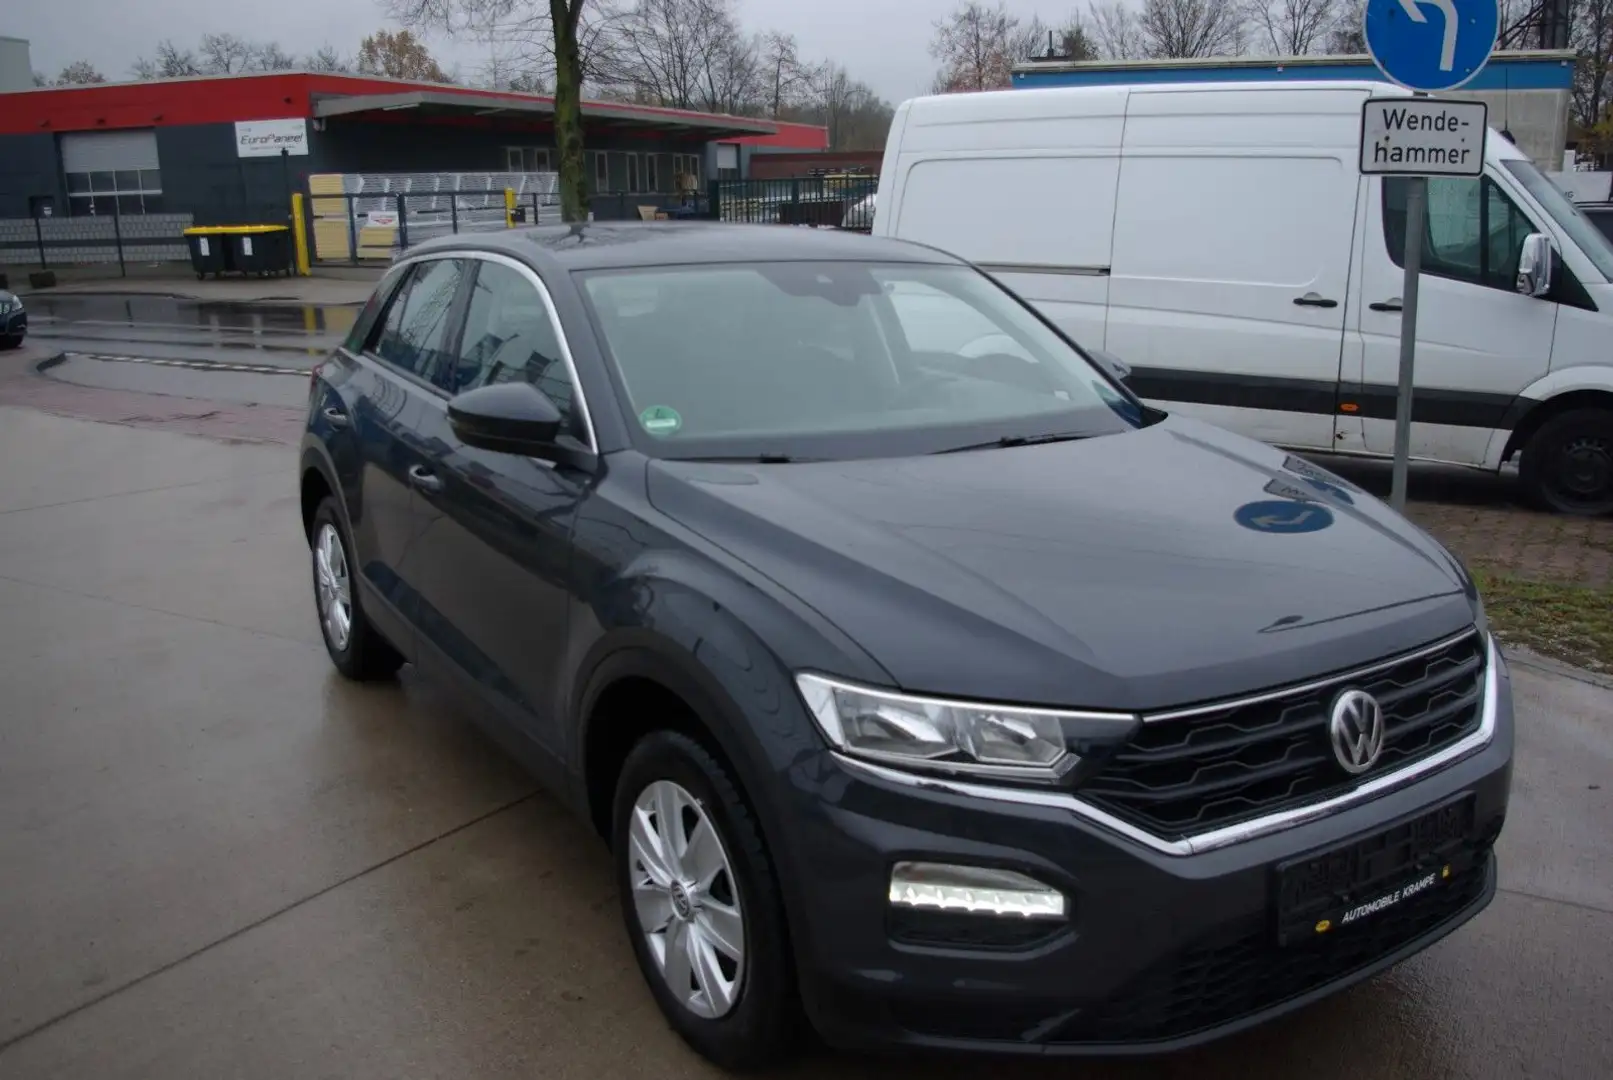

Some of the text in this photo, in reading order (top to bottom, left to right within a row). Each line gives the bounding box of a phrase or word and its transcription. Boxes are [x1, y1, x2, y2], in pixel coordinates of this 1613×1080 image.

[1382, 108, 1469, 132] Wende-
[1374, 141, 1470, 164] hammer
[1341, 872, 1436, 924] AUTOMOBILE KRAMPE
